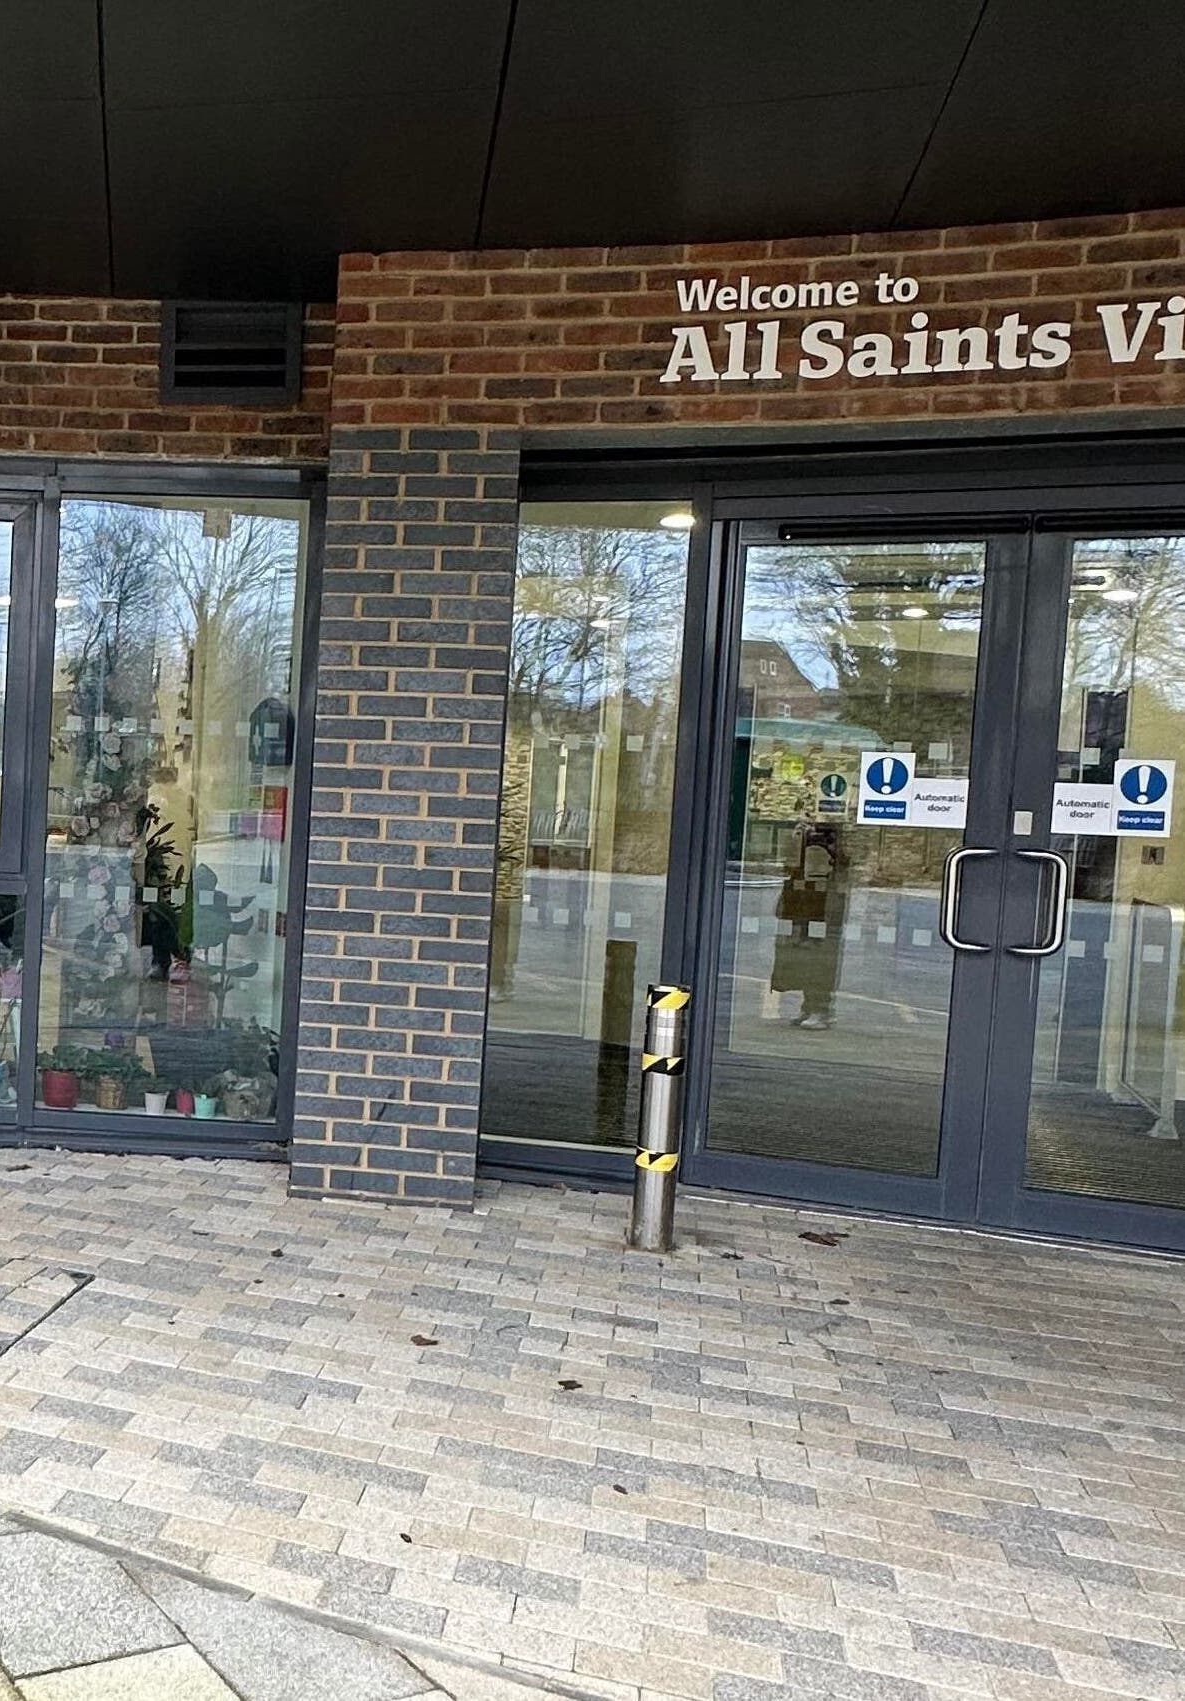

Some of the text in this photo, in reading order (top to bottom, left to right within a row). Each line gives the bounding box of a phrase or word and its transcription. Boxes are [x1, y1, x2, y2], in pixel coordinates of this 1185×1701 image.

[676, 272, 919, 312] Welcome to
[659, 320, 782, 384] All
[798, 311, 1072, 380] Saints
[914, 793, 965, 803] Automatic
[864, 804, 905, 814] Keep clear
[927, 804, 952, 812] door
[1056, 799, 1110, 809] Automatic
[1069, 810, 1095, 818] door
[1118, 815, 1164, 825] Keep clear
